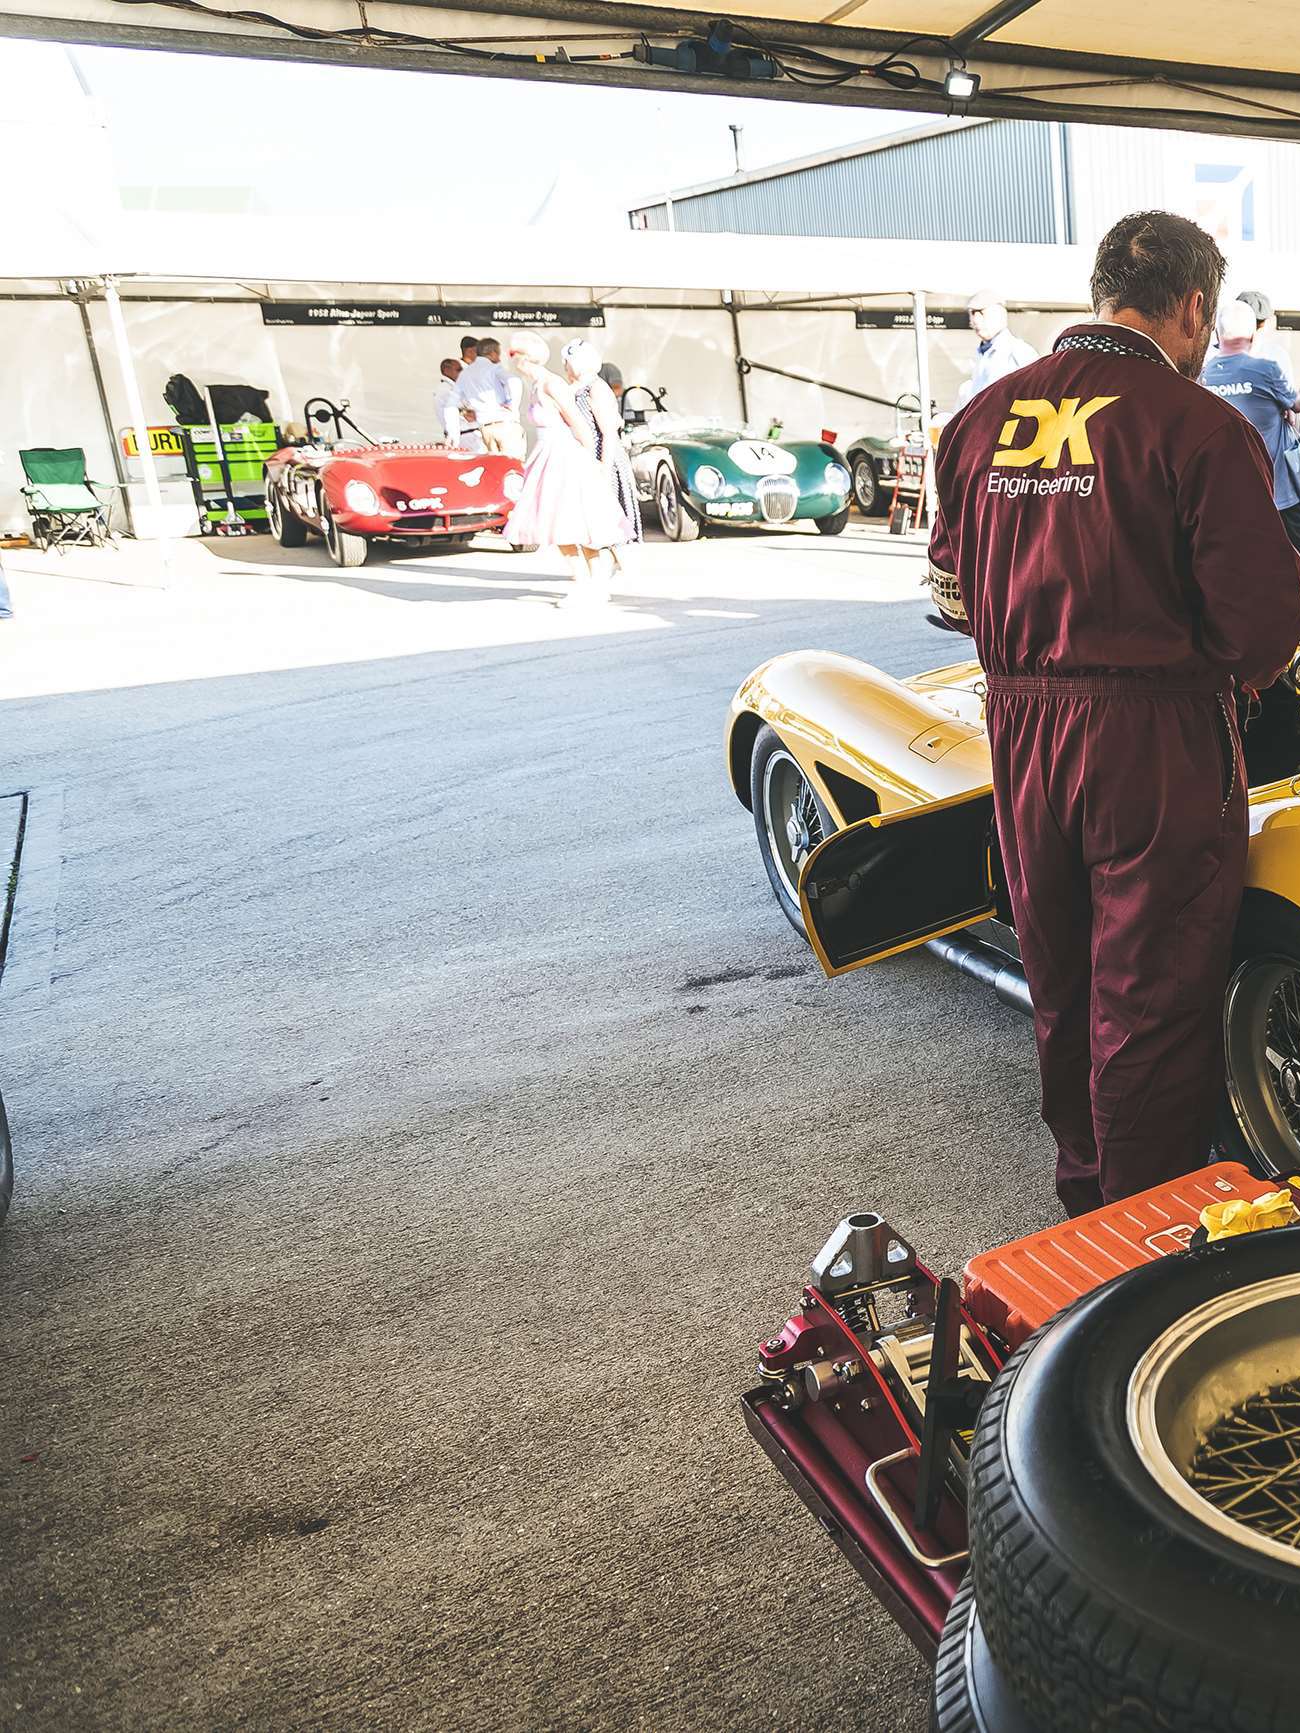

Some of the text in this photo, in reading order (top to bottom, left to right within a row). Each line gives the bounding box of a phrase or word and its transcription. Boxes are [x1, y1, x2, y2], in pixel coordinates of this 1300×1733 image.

[1206, 381, 1253, 397] RONAS
[992, 396, 1121, 469] DK
[987, 470, 1096, 499] Engineering
